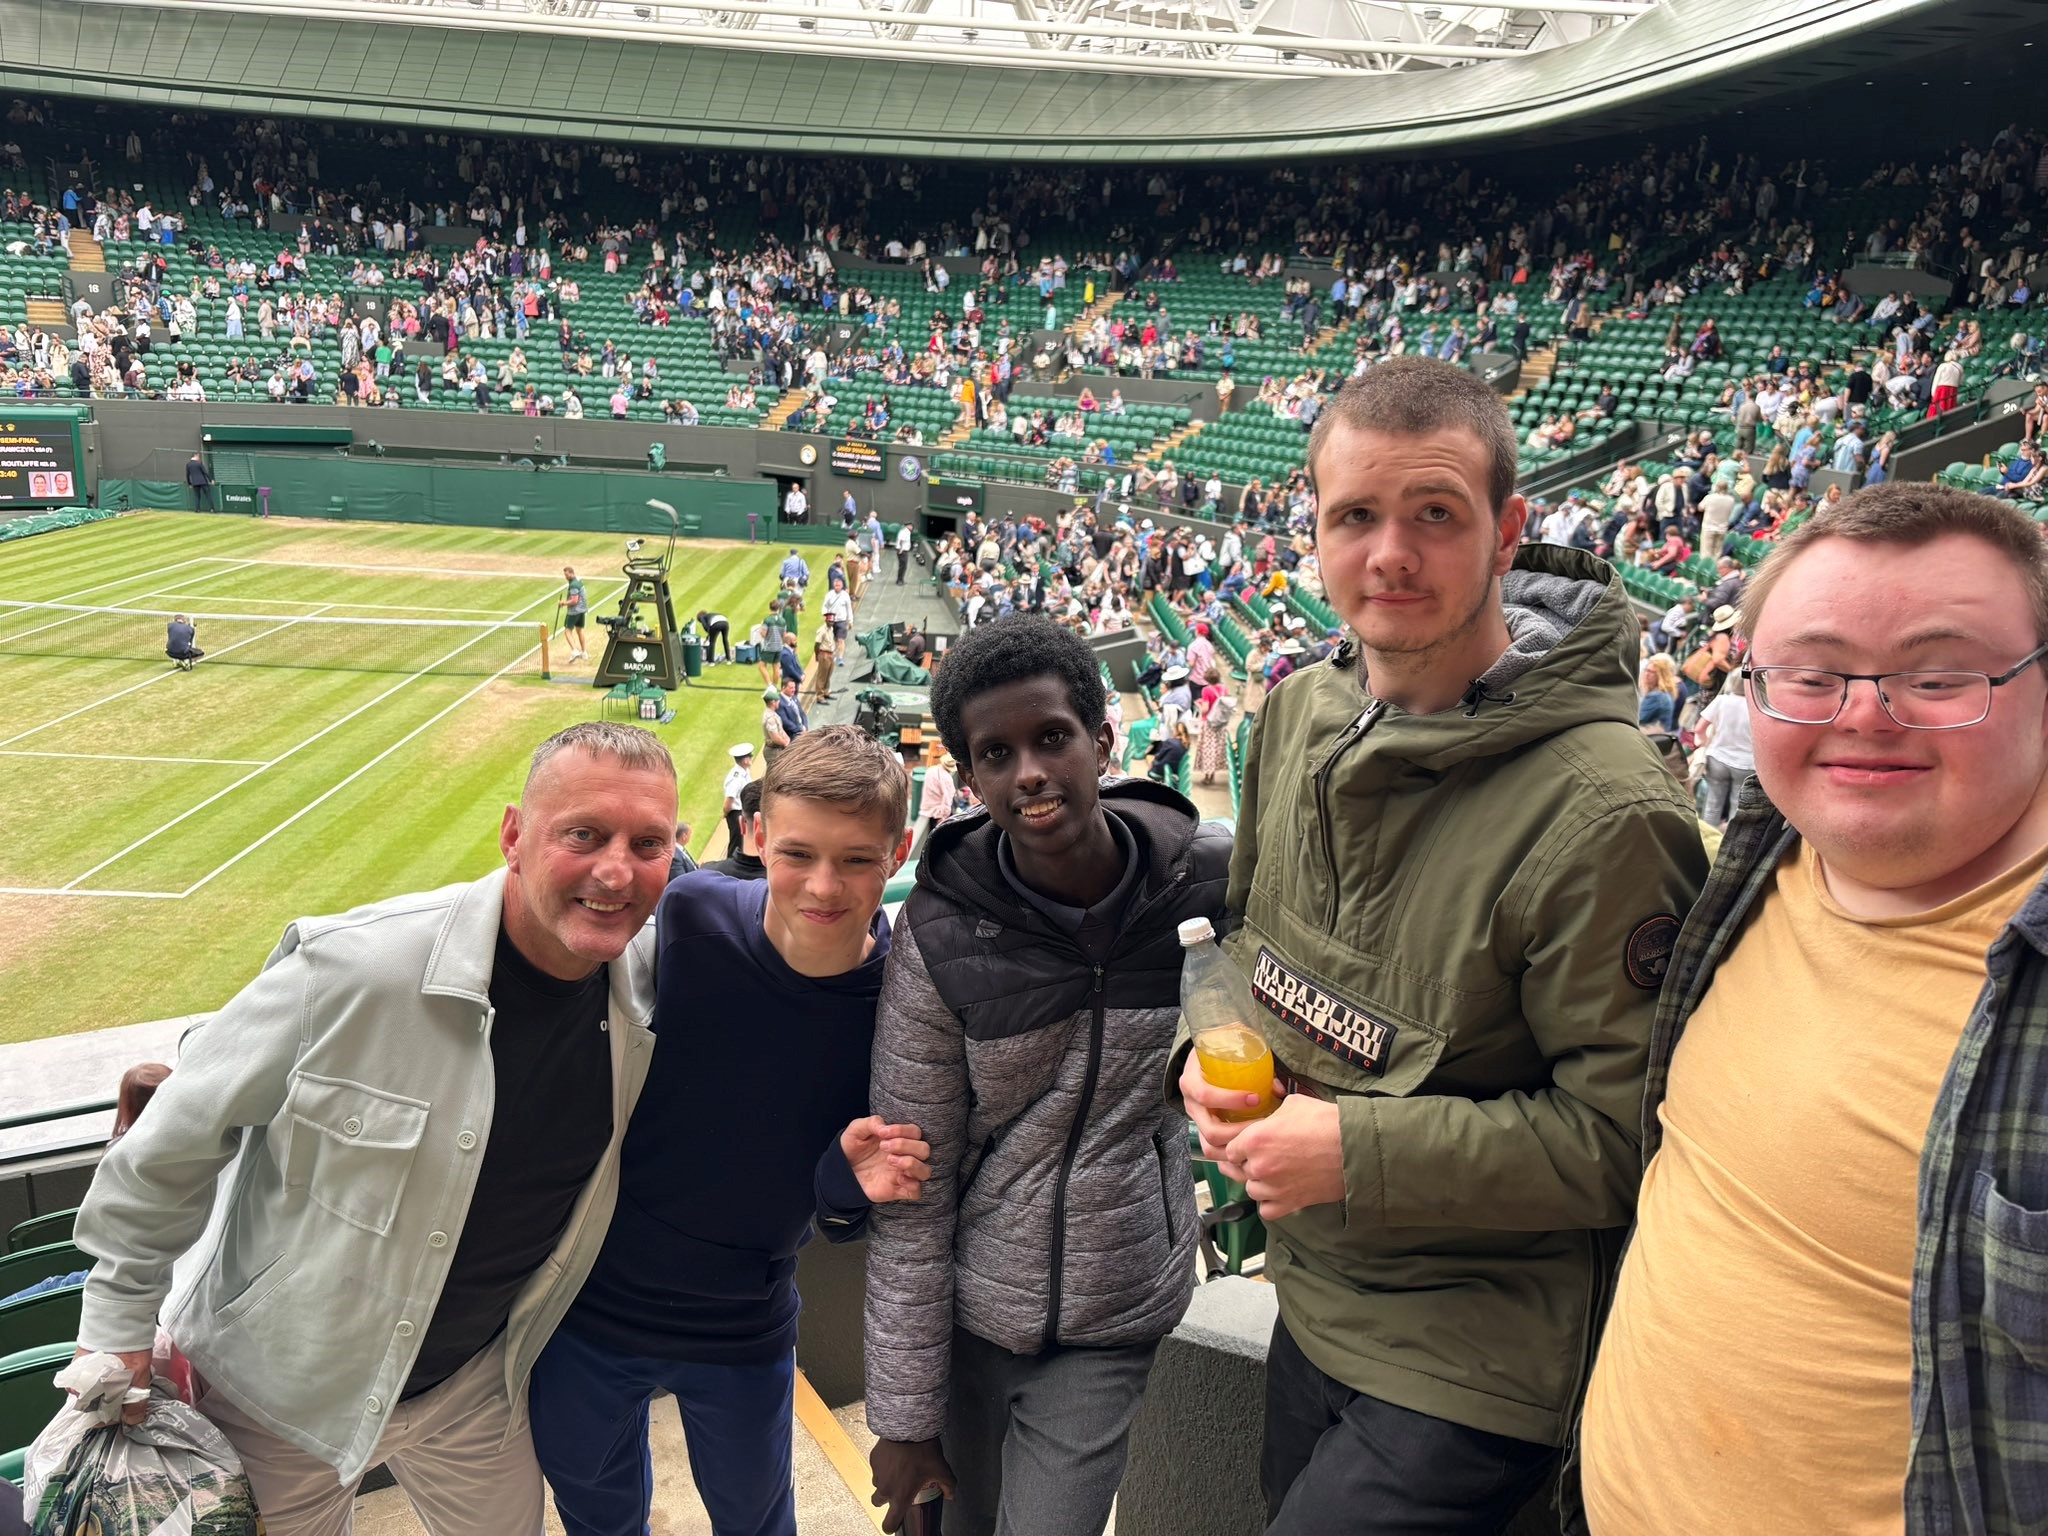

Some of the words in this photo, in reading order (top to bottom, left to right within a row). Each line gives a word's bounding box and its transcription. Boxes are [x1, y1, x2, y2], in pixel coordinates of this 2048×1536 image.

[69, 170, 79, 179] 19
[381, 197, 390, 205] 21
[839, 329, 851, 339] 20
[1045, 341, 1057, 350] 22
